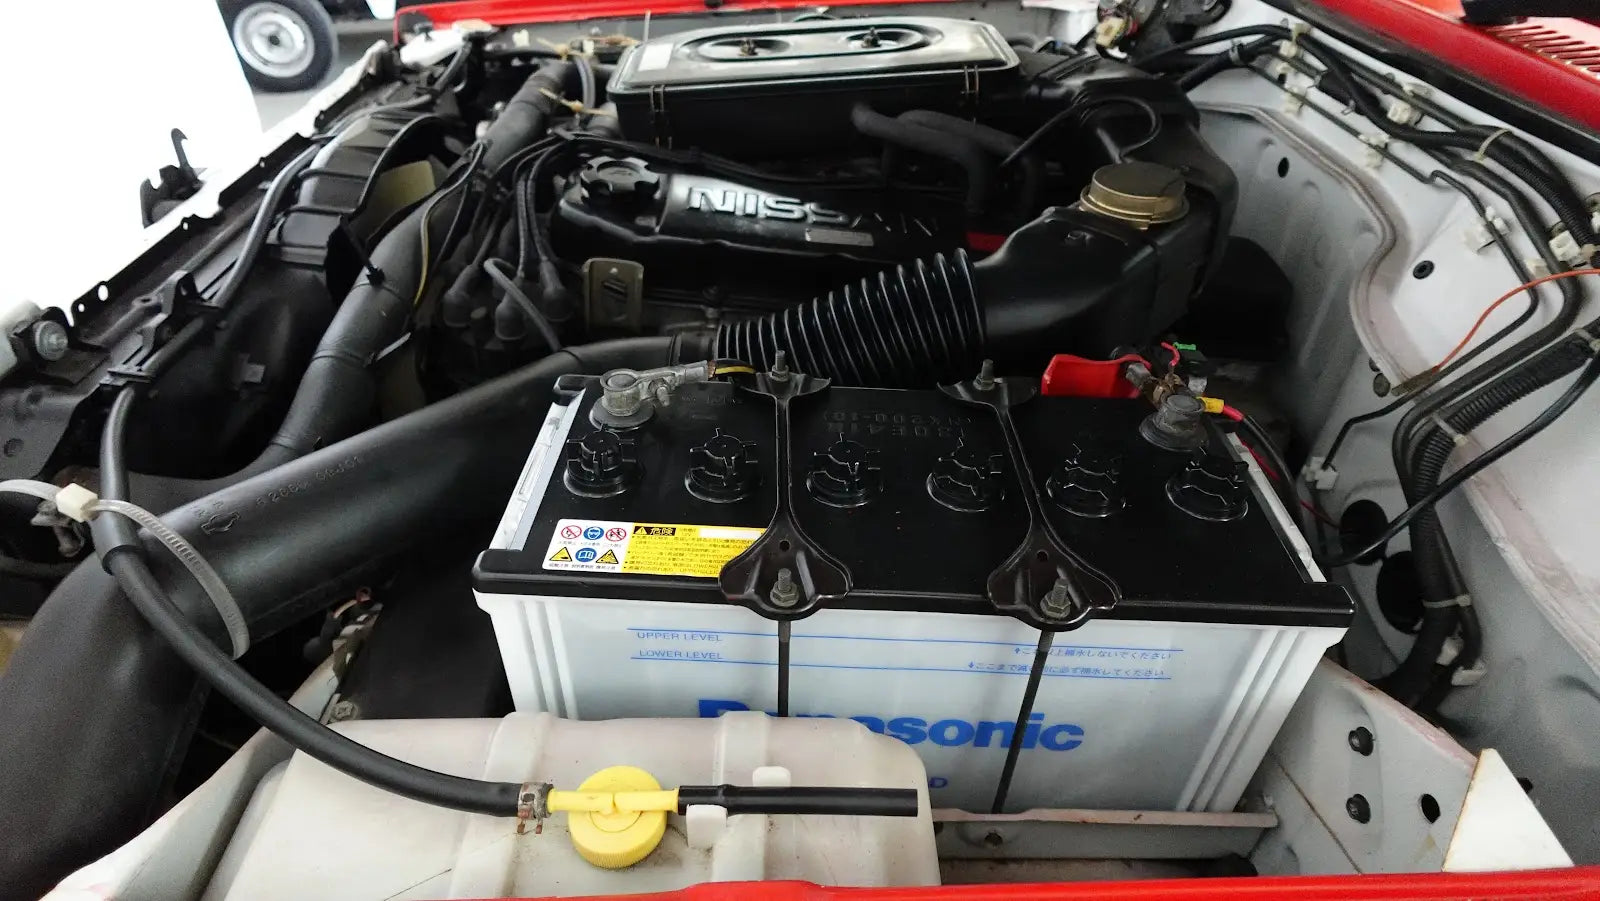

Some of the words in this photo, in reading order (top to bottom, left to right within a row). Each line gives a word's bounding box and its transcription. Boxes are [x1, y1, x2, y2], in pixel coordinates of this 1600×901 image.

[687, 186, 938, 237] NISSAN
[637, 632, 680, 640] UPPER
[684, 634, 723, 642] LEVEL
[639, 650, 682, 658] LOWER
[686, 651, 724, 660] LEVEL
[1022, 648, 1171, 660] こ以上補水しないでください
[976, 662, 1164, 677] ここまで減に必ず補水してください
[699, 699, 1085, 751] Psonic
